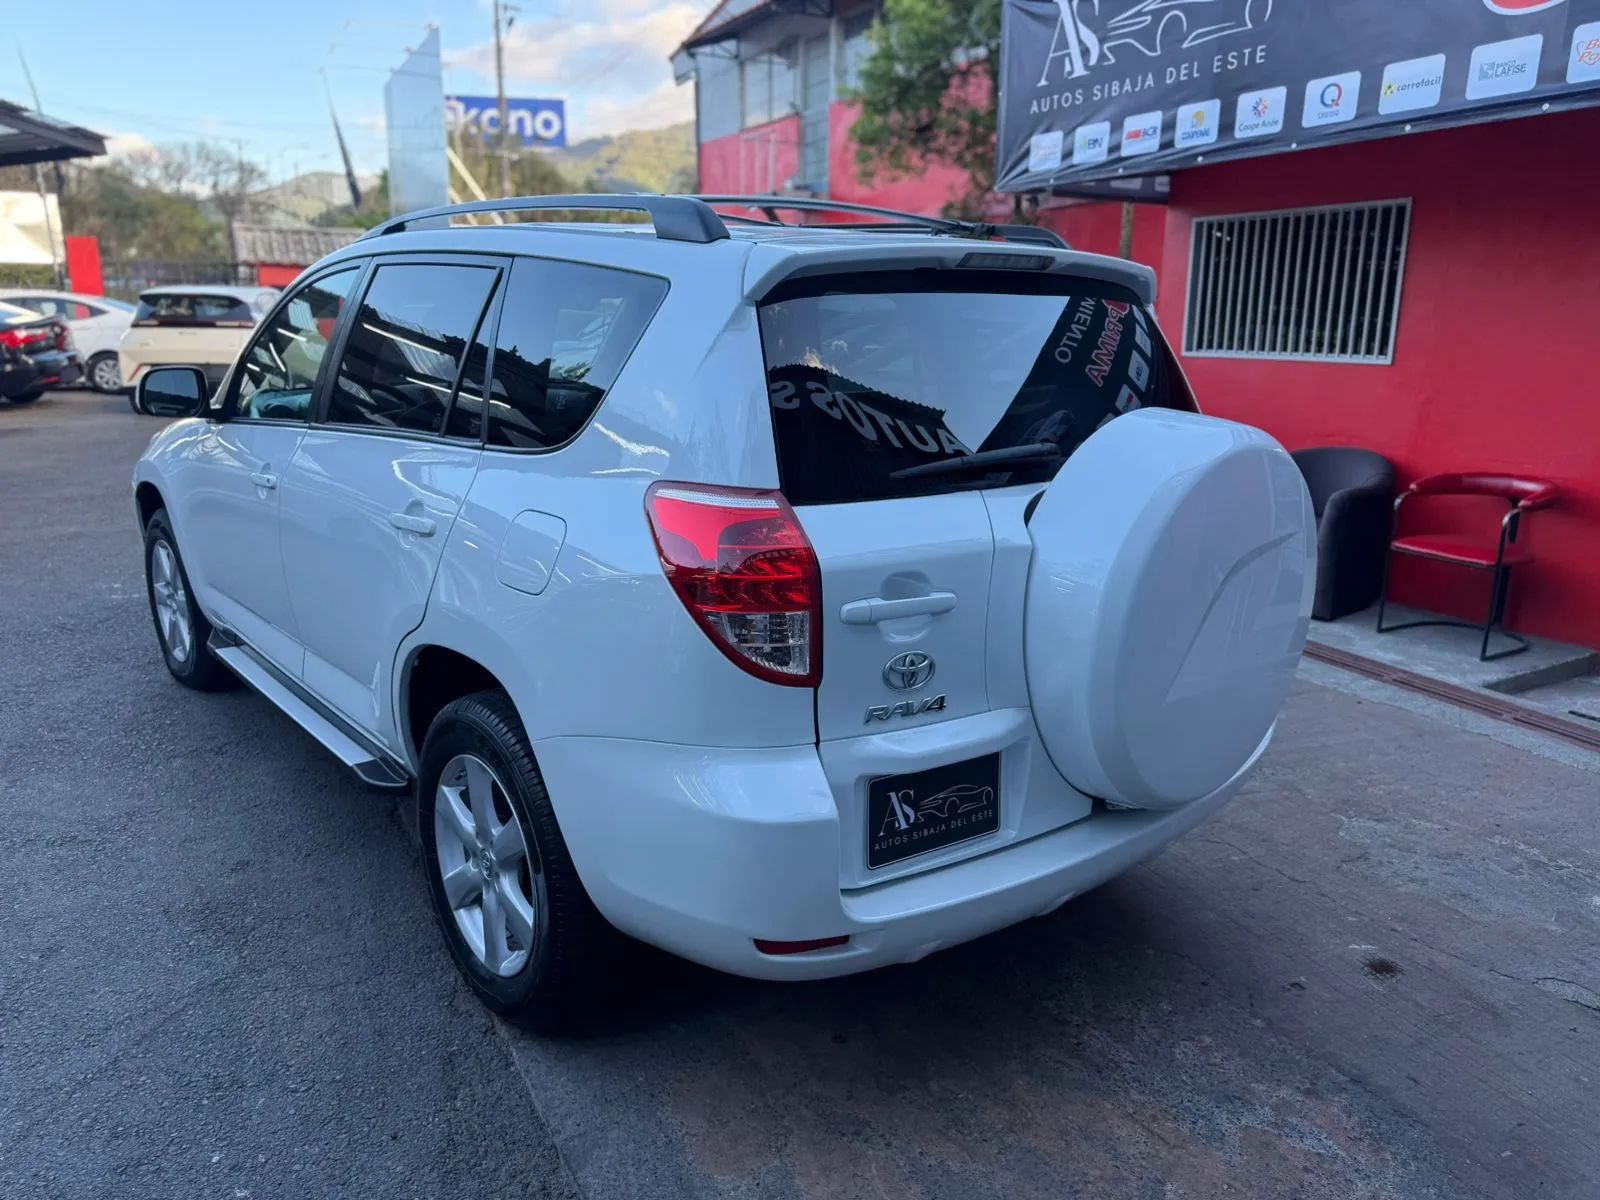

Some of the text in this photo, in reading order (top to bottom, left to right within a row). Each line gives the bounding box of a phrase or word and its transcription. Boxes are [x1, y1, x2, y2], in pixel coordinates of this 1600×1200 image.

[1029, 44, 1267, 116] AUTOS SIBAJA DEL ESTE
[1494, 63, 1527, 78] LAFISE
[864, 693, 947, 725] RAV4
[874, 809, 993, 851] AUTOS SIBAJA DEL ESTE
